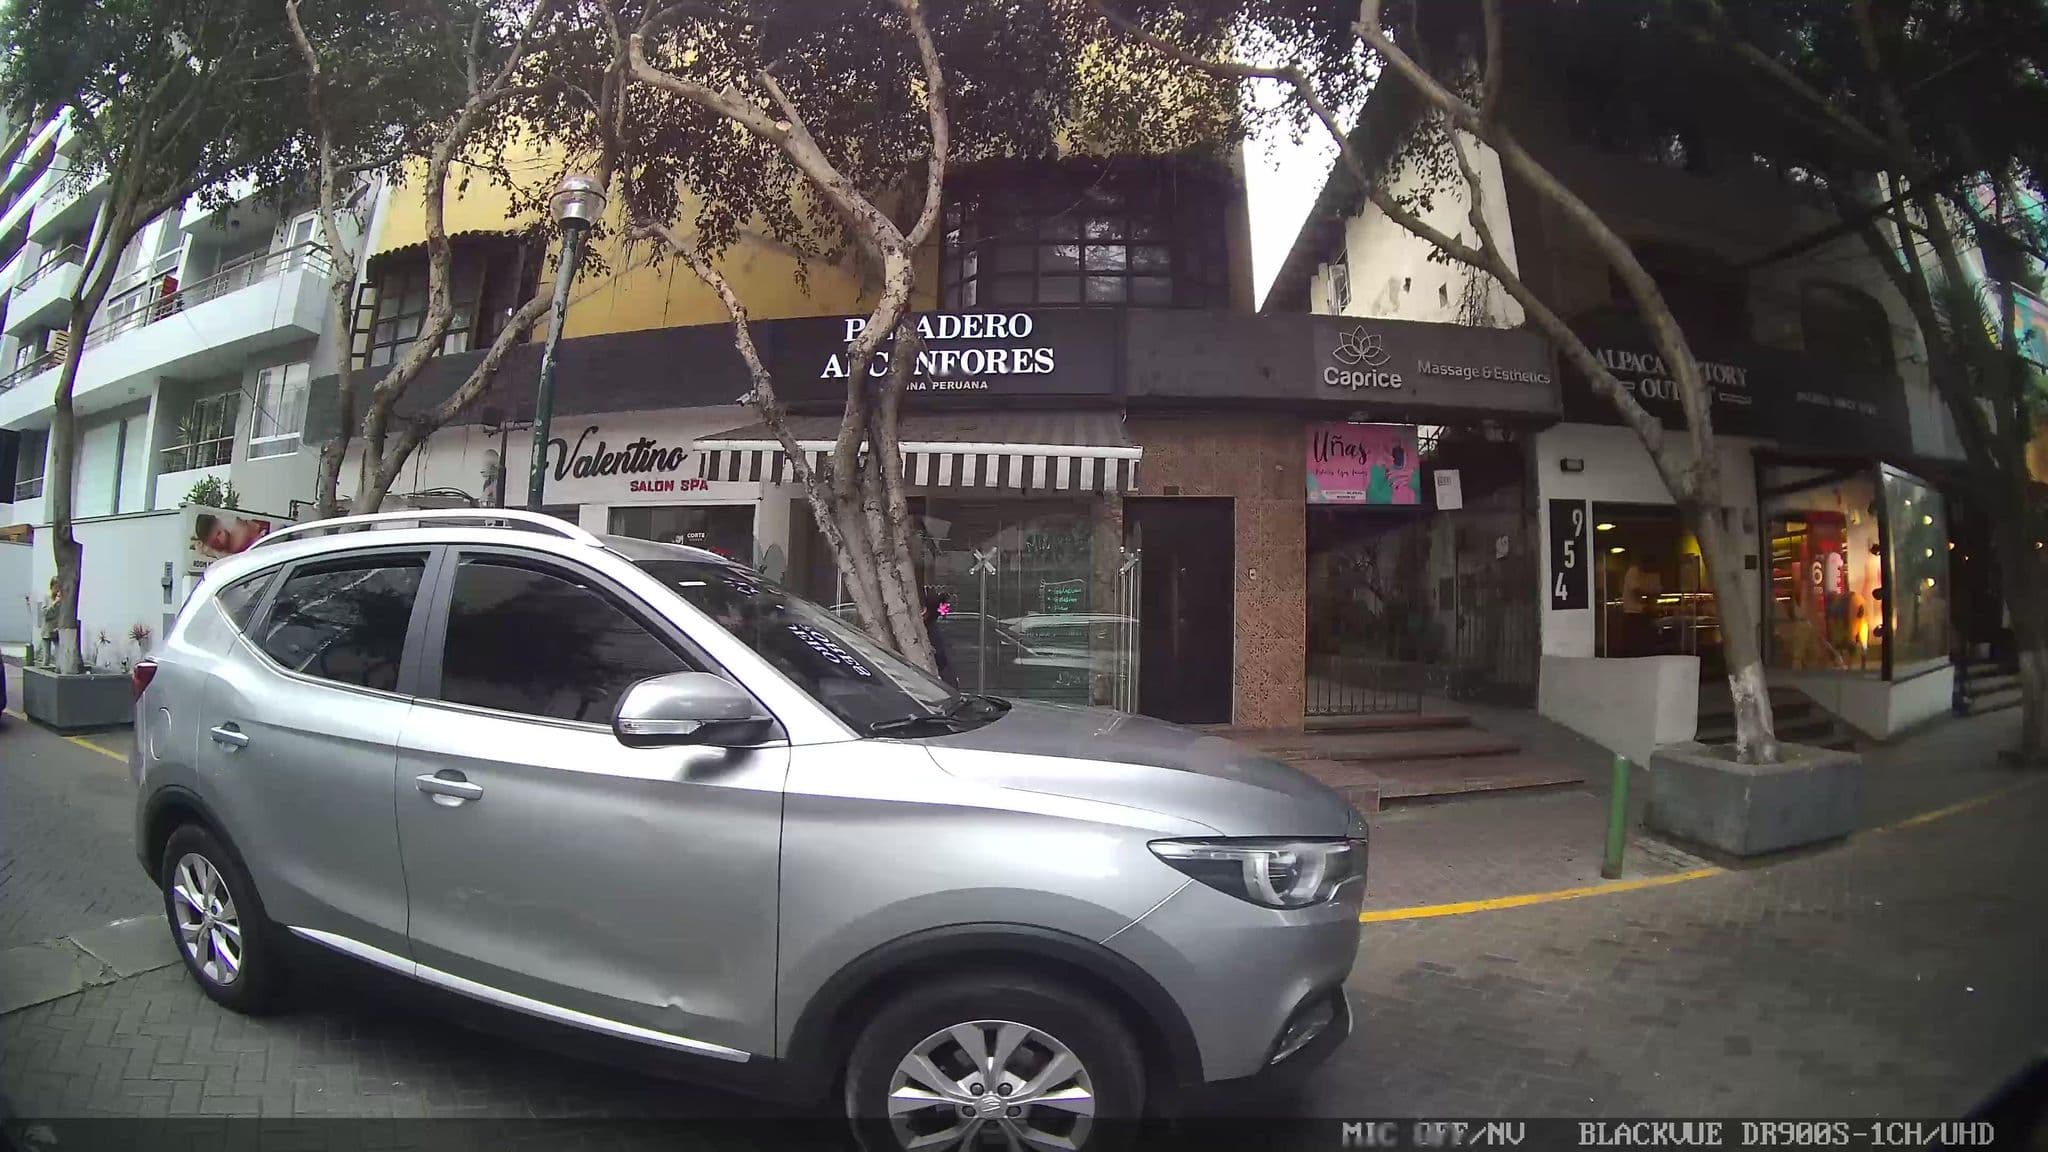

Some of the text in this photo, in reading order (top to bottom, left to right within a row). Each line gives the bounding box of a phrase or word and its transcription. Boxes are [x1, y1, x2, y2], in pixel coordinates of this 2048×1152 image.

[843, 313, 1034, 342] PADERO
[820, 347, 1055, 379] ACNFORES
[1417, 360, 1551, 385] Massage & Esthetics
[1596, 349, 1667, 376] ALPACA
[932, 380, 988, 390] PERUANA
[1323, 366, 1402, 391] Caprice
[546, 425, 688, 482] Valentino
[1313, 431, 1368, 465] Uñas
[630, 478, 709, 492] SALON SPA
